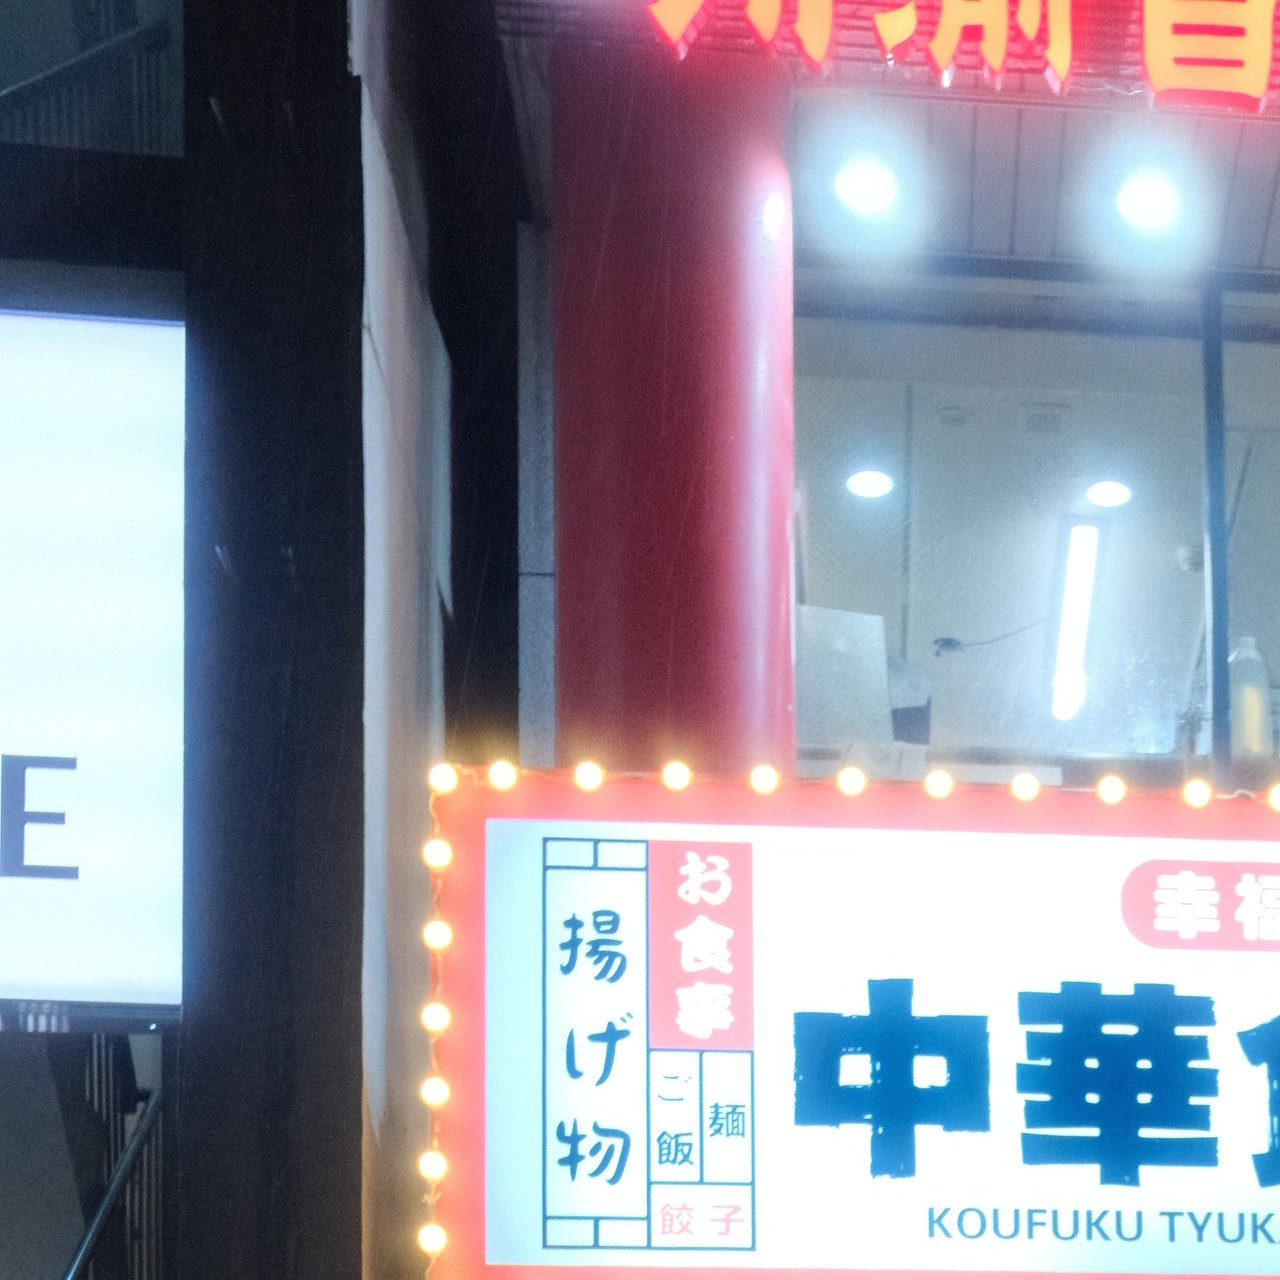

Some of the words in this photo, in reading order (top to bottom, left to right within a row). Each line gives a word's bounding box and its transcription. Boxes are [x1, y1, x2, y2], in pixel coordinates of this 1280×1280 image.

[0, 754, 79, 880] E
[674, 851, 735, 1039] お食事
[556, 910, 632, 1185] 揚げ物
[657, 1073, 694, 1166] ご飯
[660, 1203, 744, 1236] 餃子
[929, 1206, 1142, 1241] KOUFUKU
